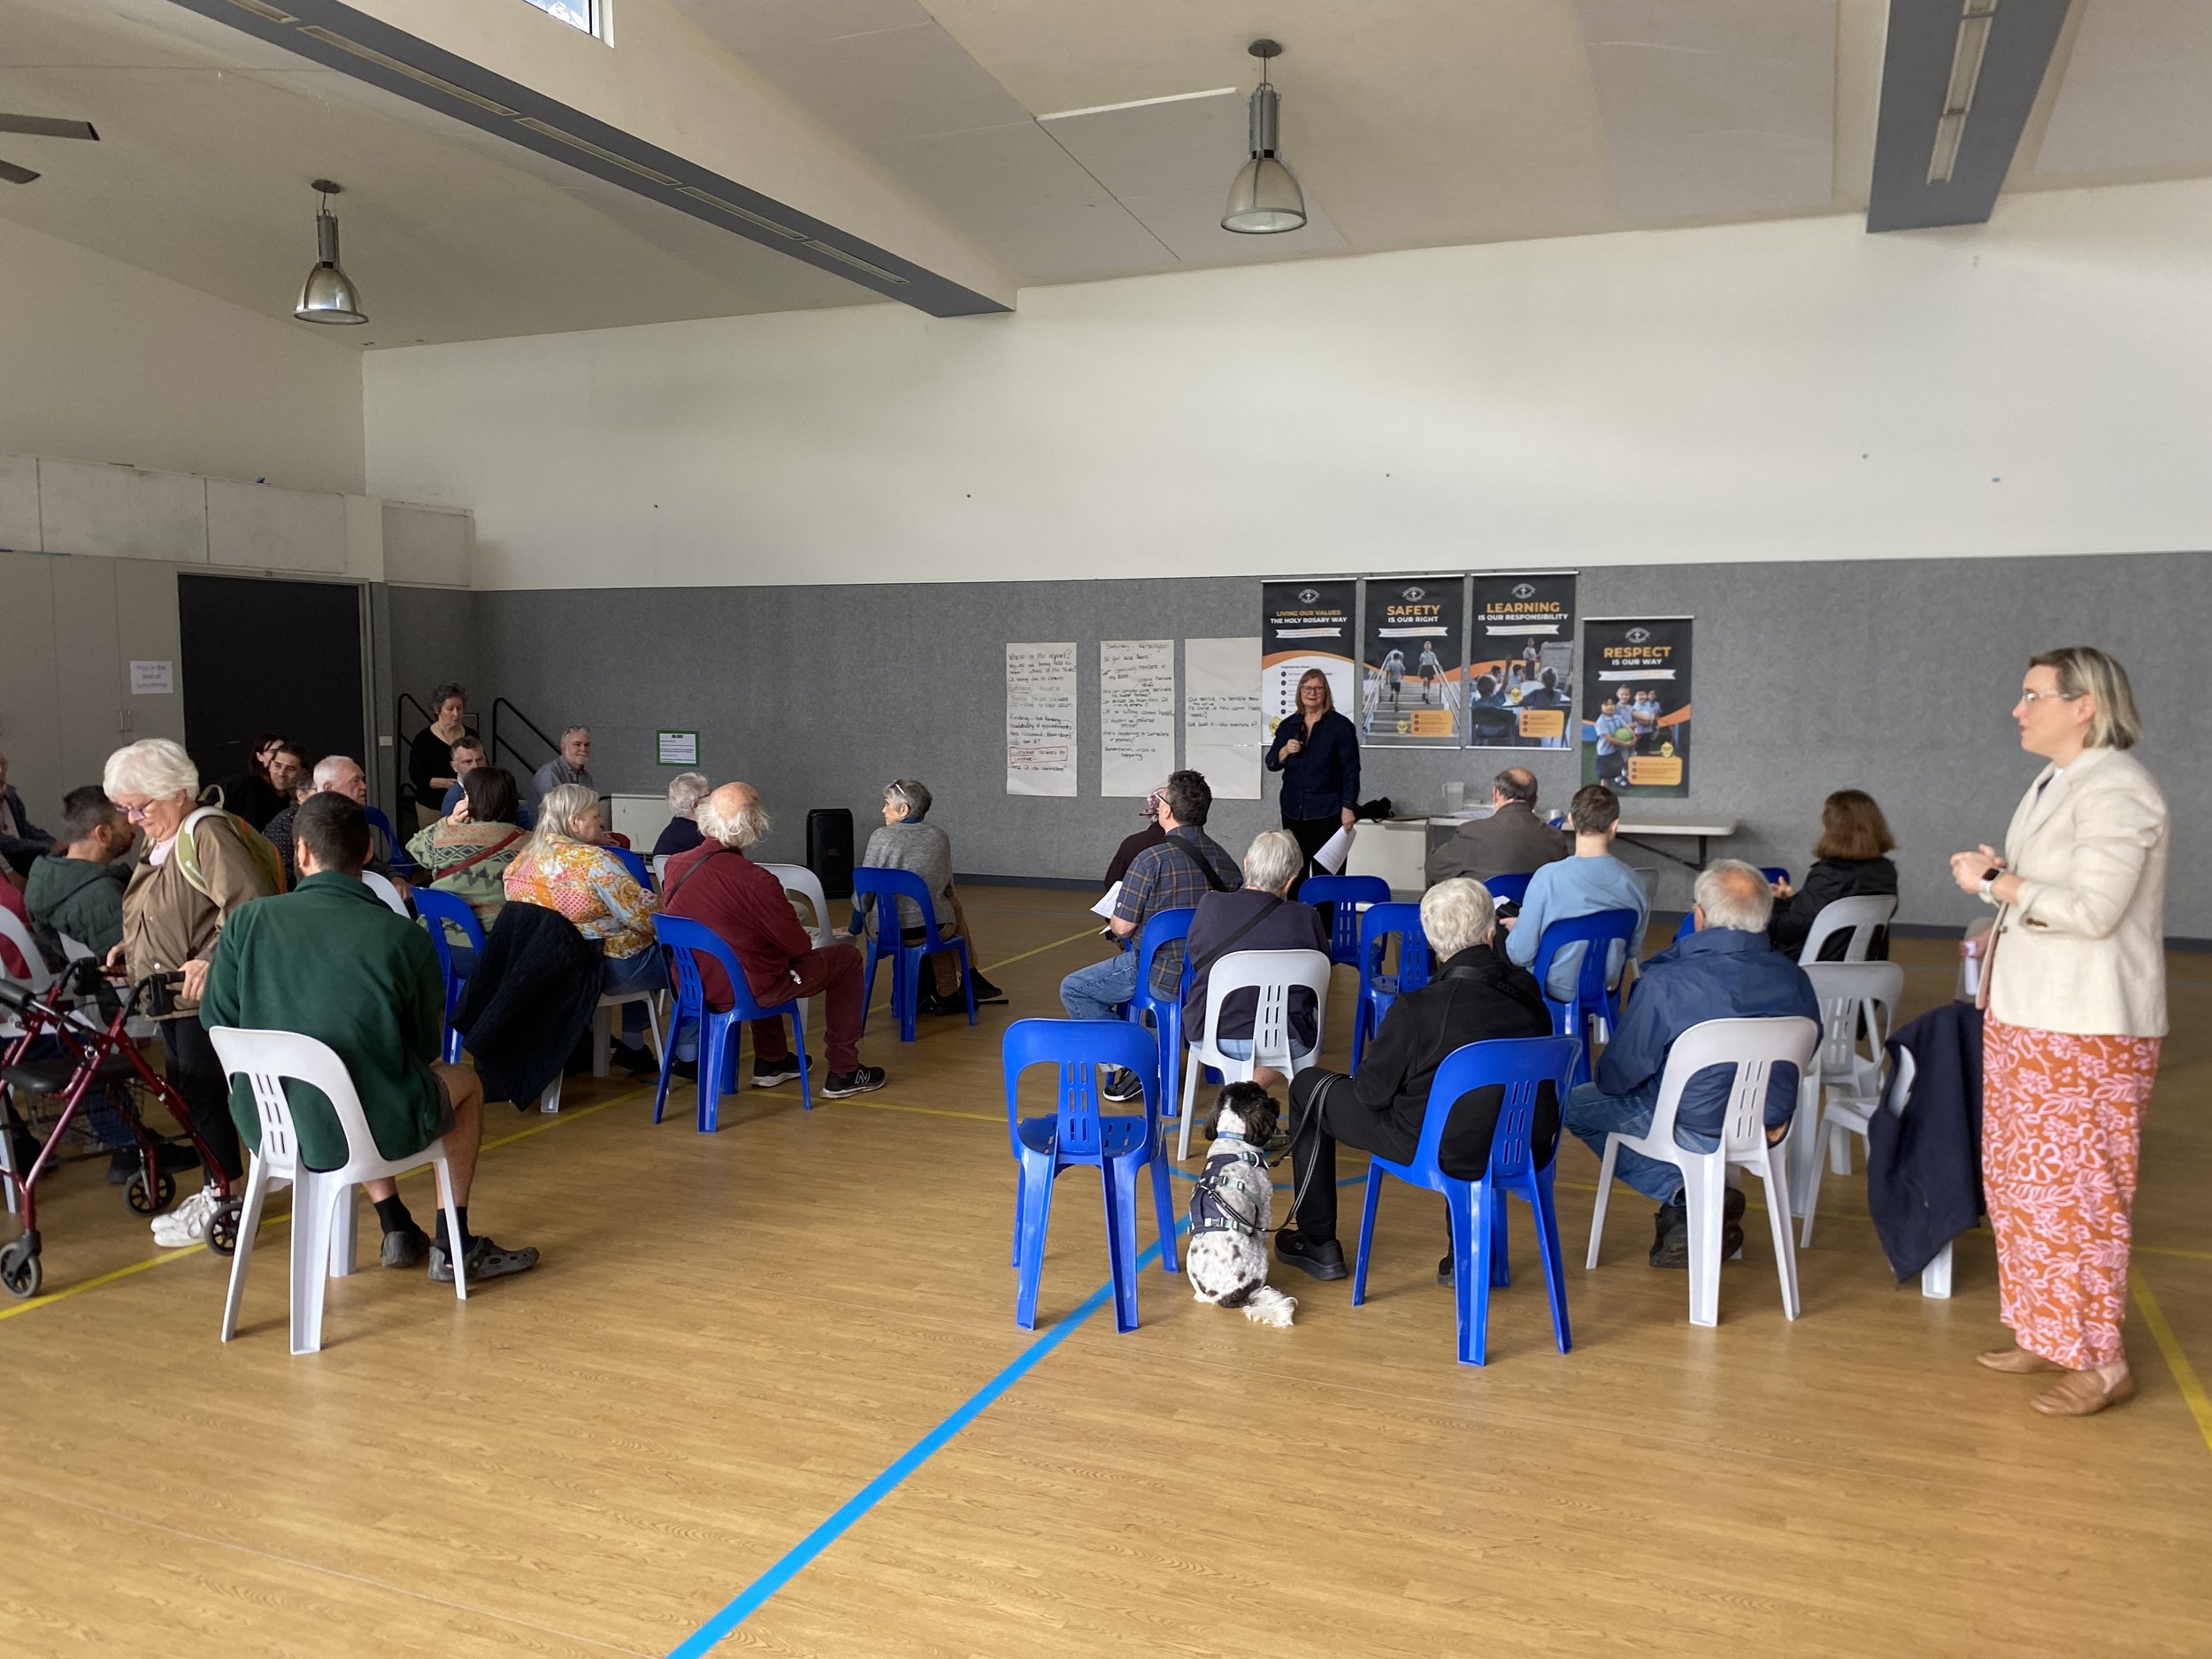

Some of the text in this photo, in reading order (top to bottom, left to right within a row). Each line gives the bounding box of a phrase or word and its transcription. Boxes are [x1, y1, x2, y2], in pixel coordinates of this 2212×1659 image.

[1386, 604, 1440, 616] SAFETY
[1486, 602, 1560, 613] LEARNING
[1603, 646, 1672, 657] RESPECT
